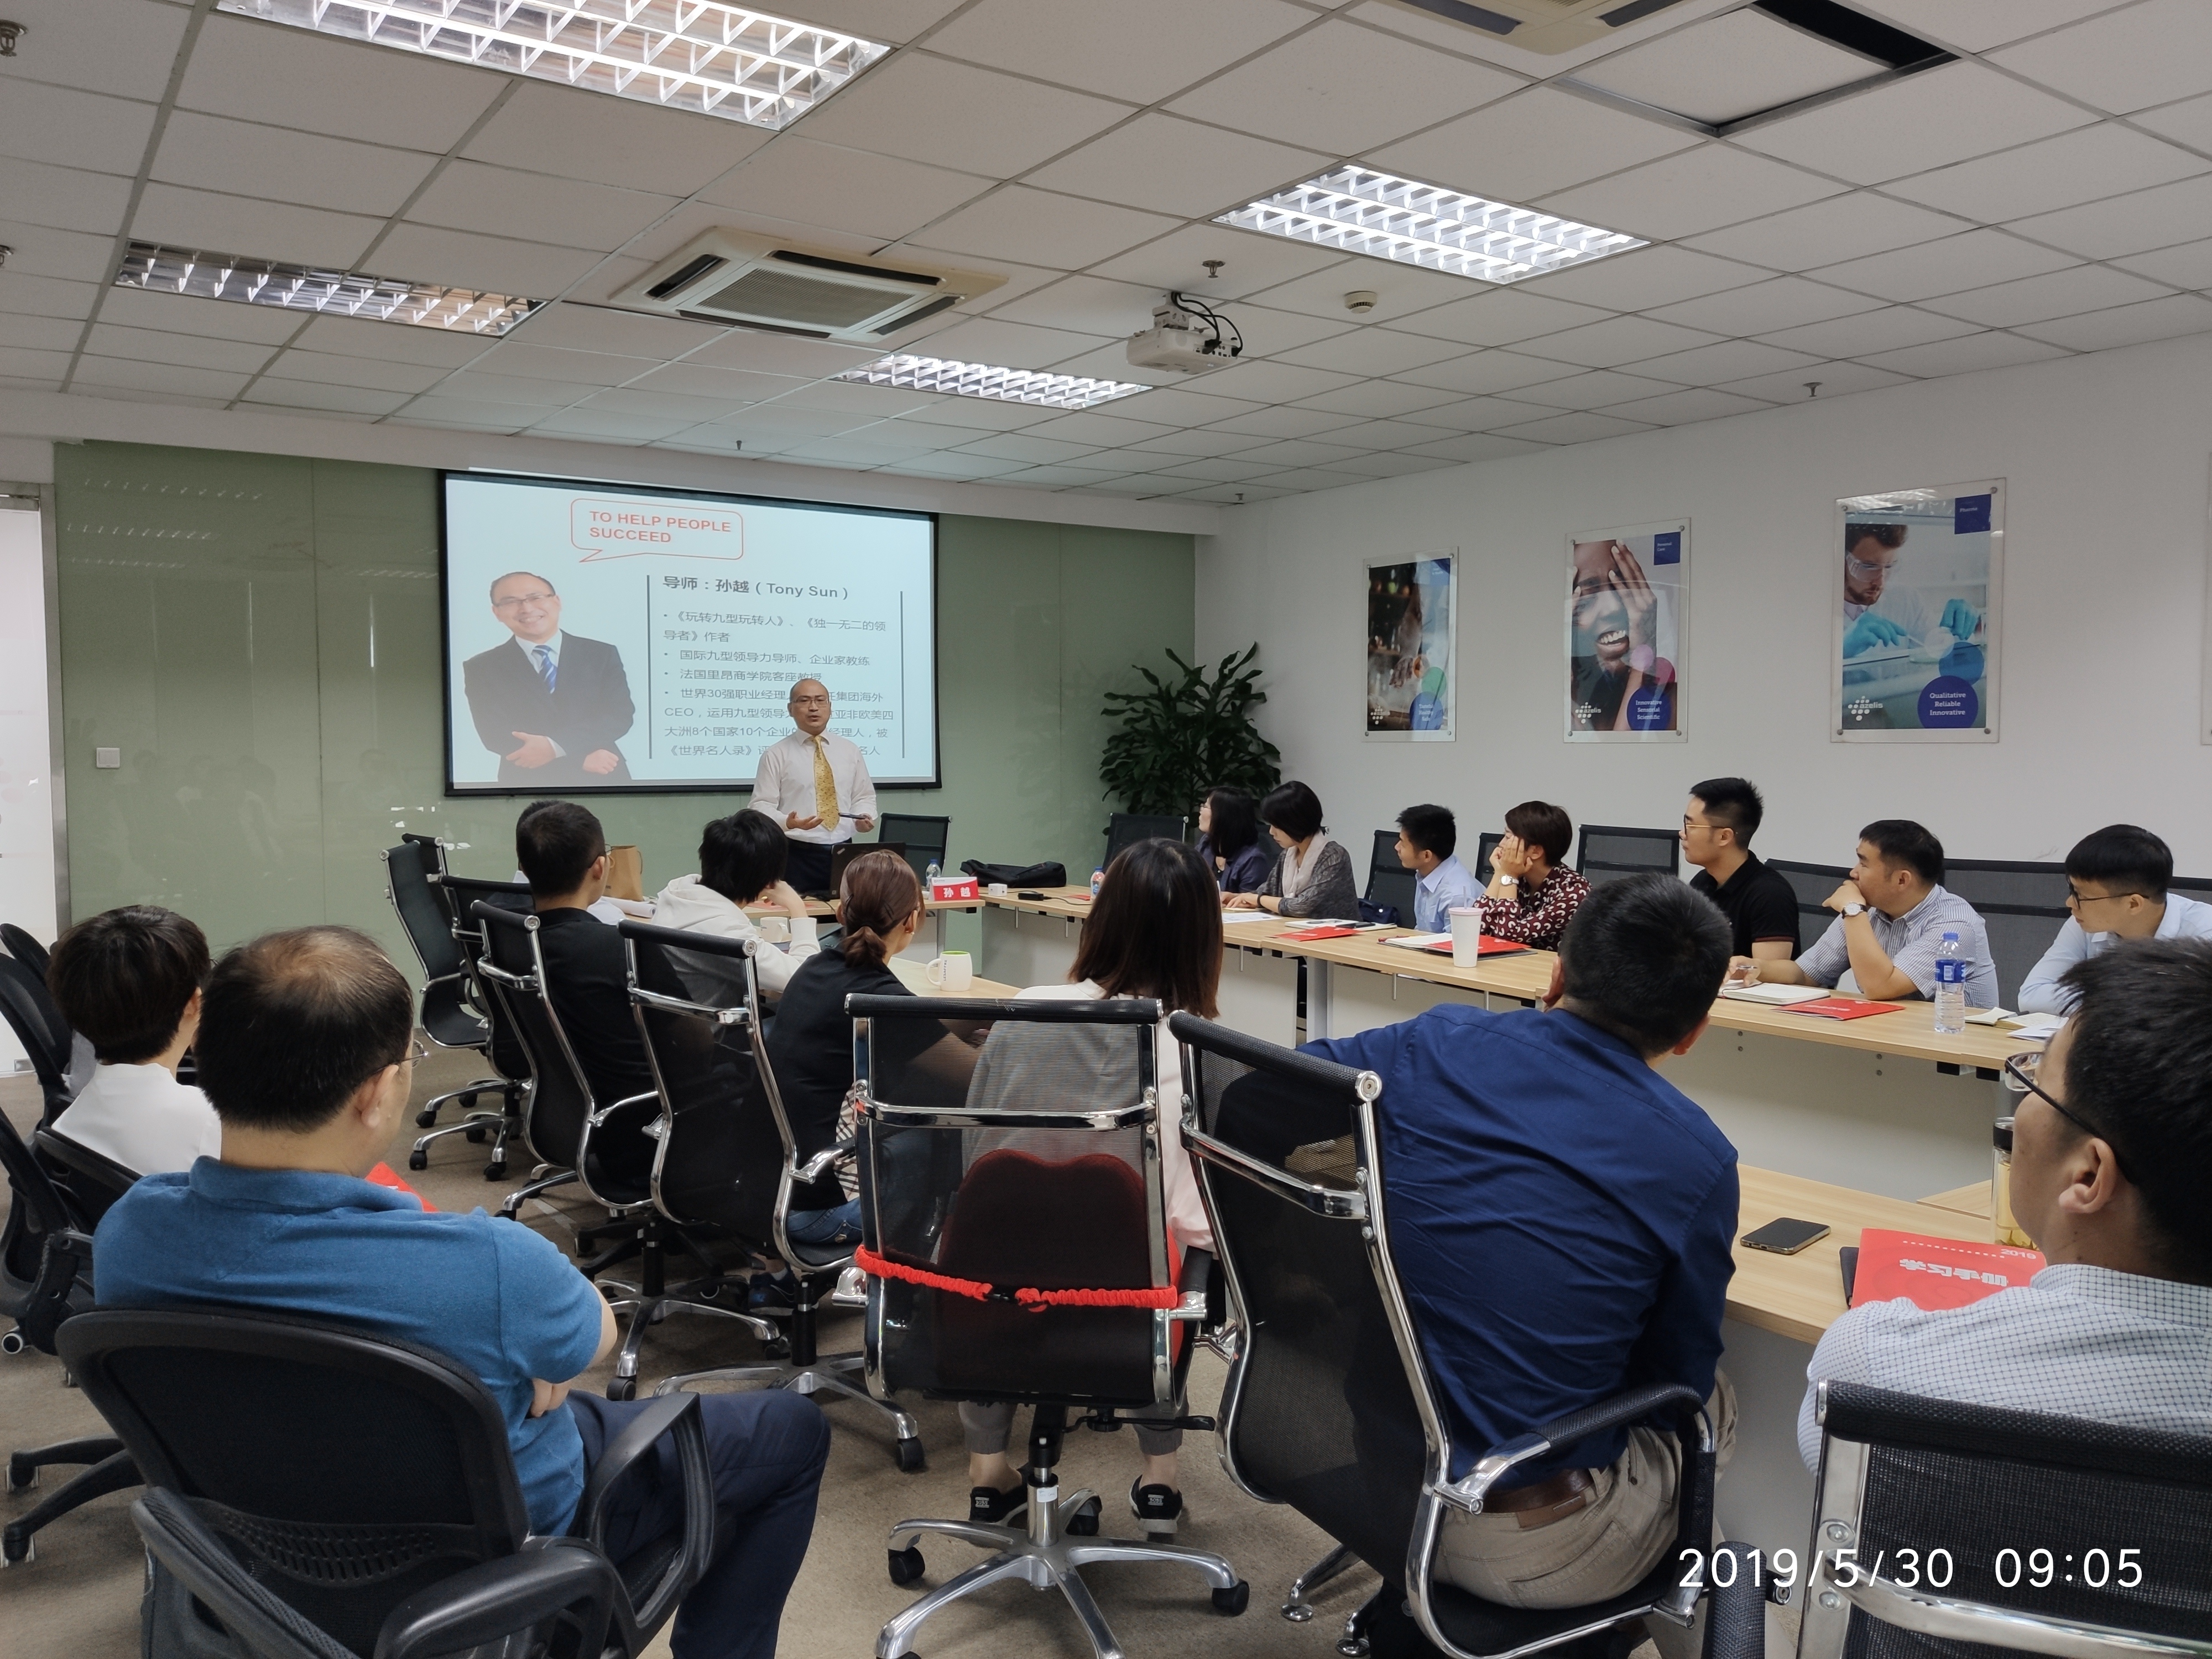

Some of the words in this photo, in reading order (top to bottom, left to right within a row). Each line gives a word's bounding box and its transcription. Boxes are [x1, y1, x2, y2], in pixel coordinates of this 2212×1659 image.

[589, 511, 612, 523] TO
[618, 513, 661, 526] HELP
[667, 517, 731, 532] PEOPLE
[589, 527, 671, 542] SUCCEED
[663, 630, 731, 643] 导者》作者
[2000, 1249, 2037, 1260] 2019
[1899, 1258, 2009, 1287] 学习手册
